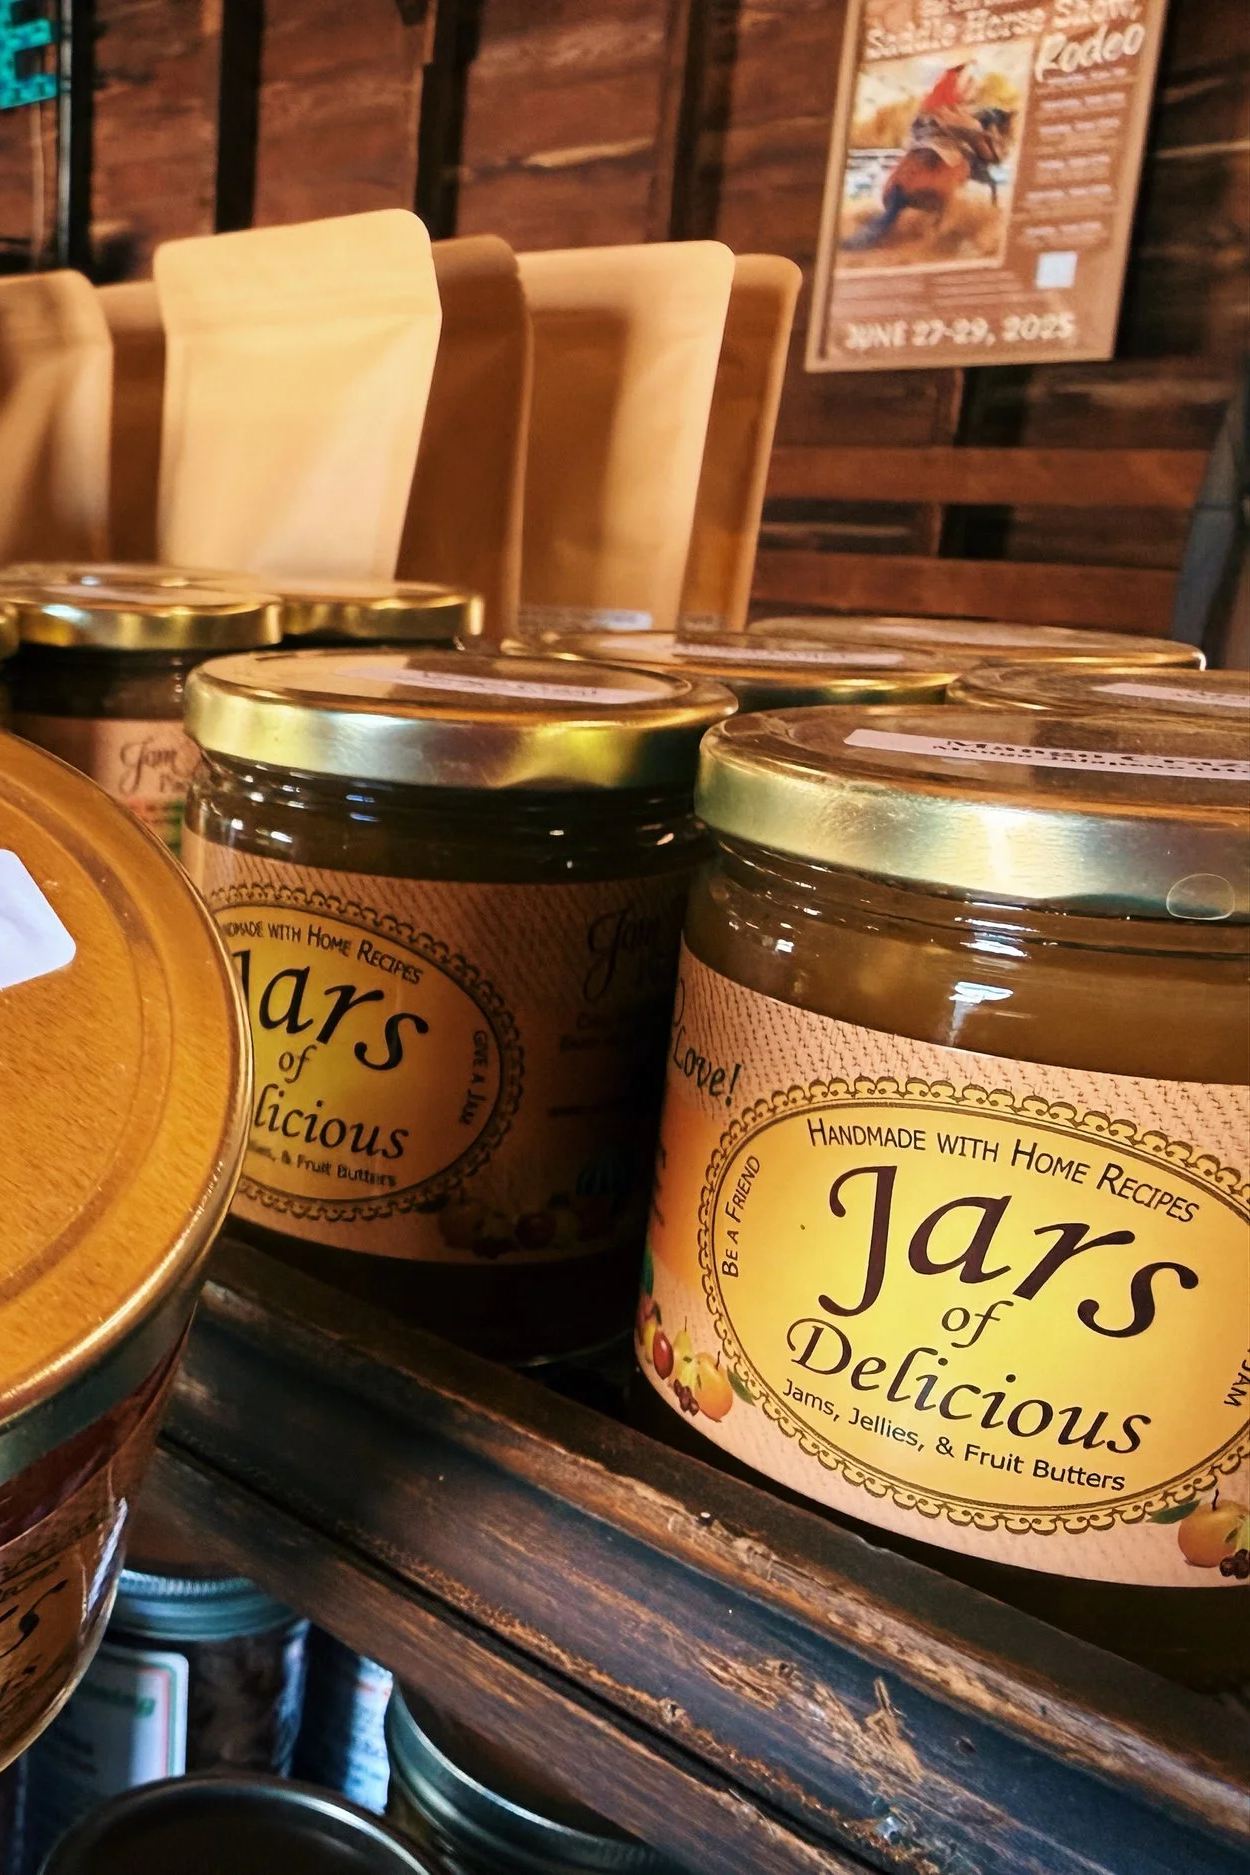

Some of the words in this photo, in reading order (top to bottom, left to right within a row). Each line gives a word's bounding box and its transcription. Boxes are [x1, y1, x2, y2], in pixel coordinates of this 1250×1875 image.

[1034, 23, 1145, 83] Rodeo
[845, 320, 907, 350] JUNE
[1002, 312, 1075, 342] 2025
[267, 923, 302, 943] WITH
[307, 924, 350, 957] HOME
[357, 939, 424, 986] RECIPES
[278, 1044, 317, 1083] of
[673, 1026, 742, 1108] Love!
[252, 1083, 410, 1160] licious
[725, 1154, 760, 1223] FRIEND
[807, 1118, 926, 1152] HANDMADE
[937, 1132, 999, 1163] WITH
[1011, 1138, 1089, 1185] HOME
[1096, 1162, 1200, 1223] RECIPES
[721, 1248, 739, 1278] BE
[726, 1229, 740, 1246] A
[818, 1164, 1200, 1339] Jars
[941, 1300, 1014, 1349] of
[786, 1317, 1152, 1455] Delicious
[782, 1378, 841, 1423] Jams,
[848, 1406, 925, 1453] Jellies,
[935, 1436, 956, 1458] &
[964, 1443, 1024, 1475] Fruit
[1032, 1458, 1126, 1492] Butters
